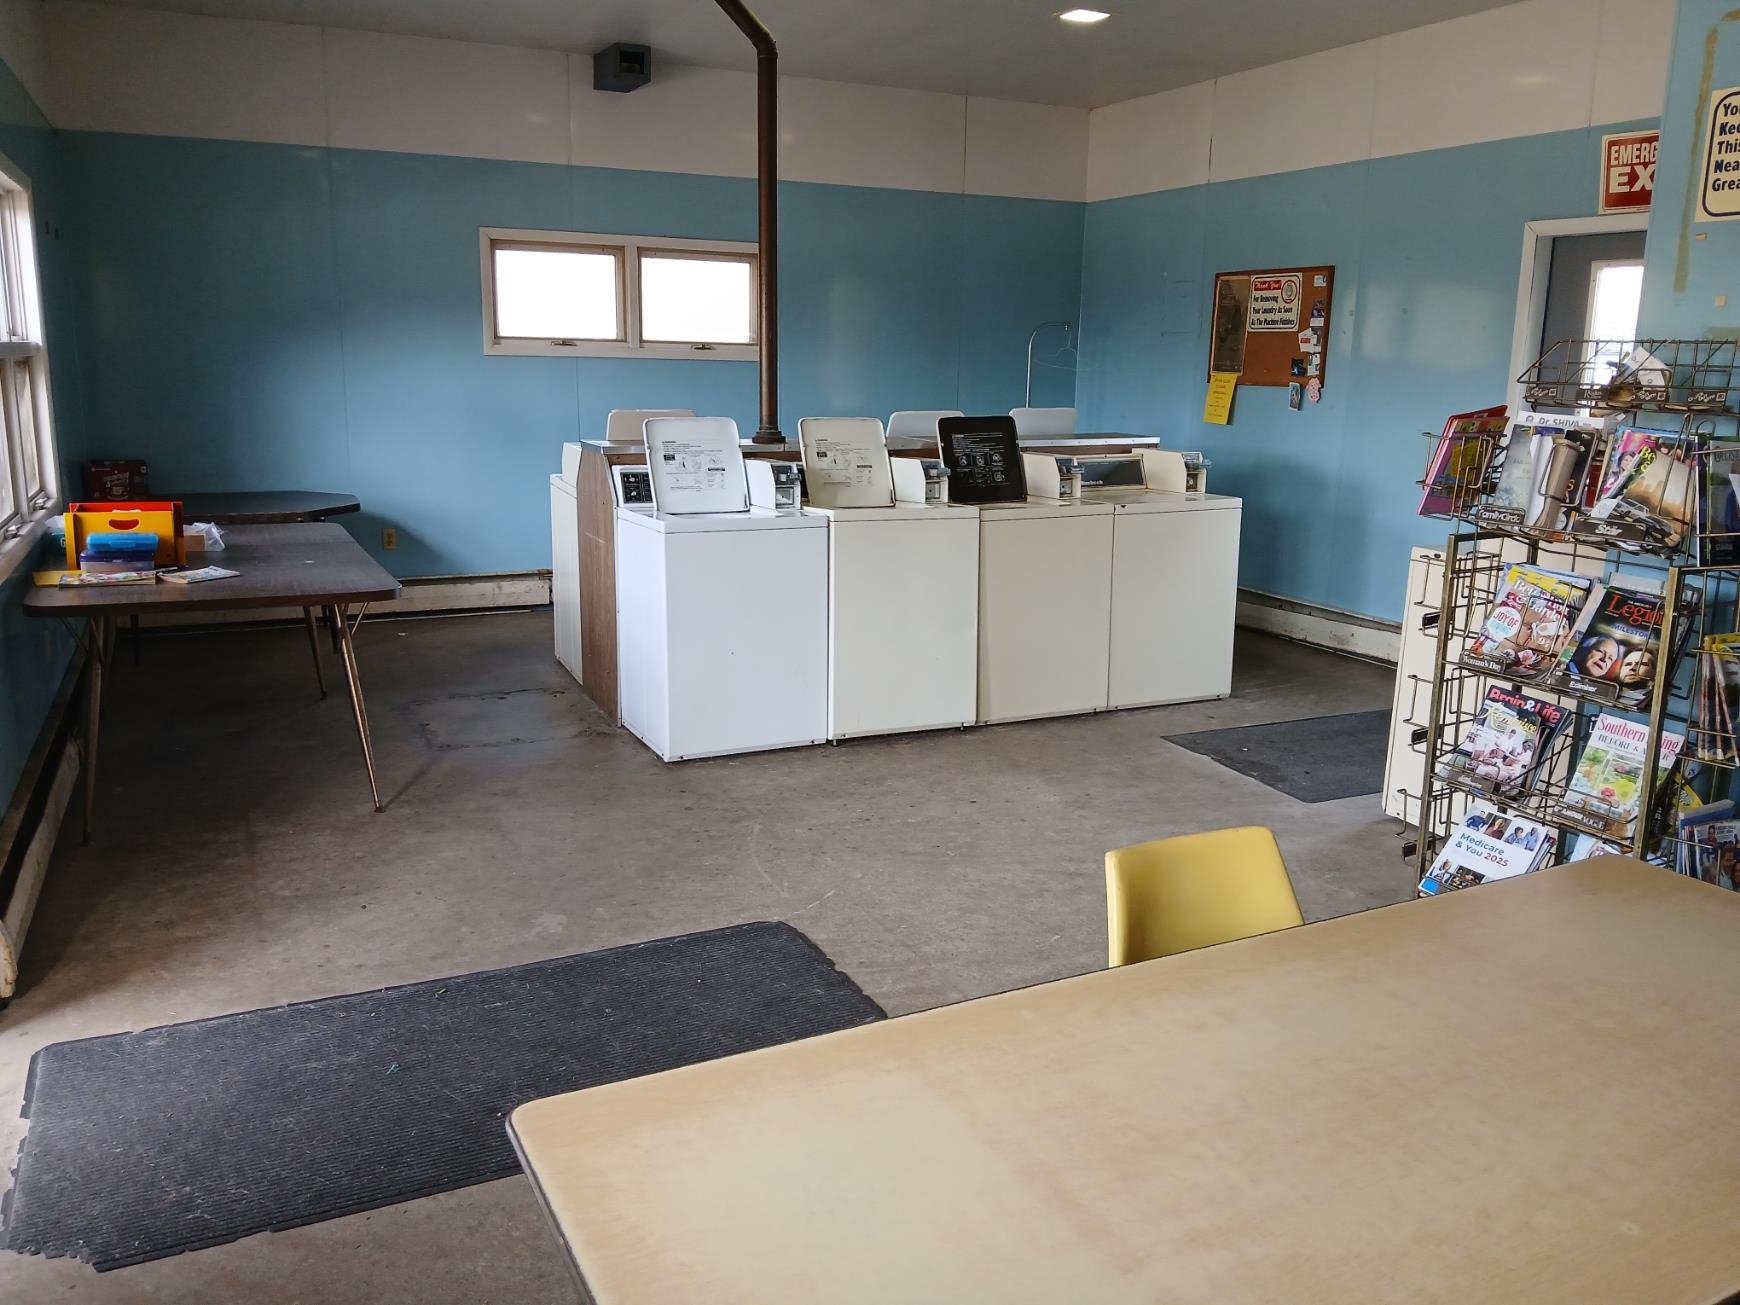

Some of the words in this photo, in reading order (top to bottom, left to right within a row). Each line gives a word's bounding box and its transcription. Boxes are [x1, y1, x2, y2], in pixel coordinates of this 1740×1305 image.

[1723, 102, 1740, 117] Yo
[1610, 141, 1659, 166] EMERG
[1608, 163, 1657, 194] EX
[1260, 294, 1279, 303] Removing
[1252, 306, 1261, 314] Your
[1261, 305, 1277, 315] Laundry
[1277, 305, 1283, 314] As
[1283, 305, 1293, 314] Soon
[1256, 317, 1264, 326] The
[1264, 317, 1279, 326] Machine
[1279, 317, 1295, 326] Finishes
[1553, 418, 1580, 428] SHIVA
[1493, 611, 1509, 623] JOY
[1507, 617, 1520, 628] OF
[1597, 717, 1647, 743] Southern
[1598, 733, 1631, 750] BEFORE
[1460, 832, 1505, 856] Medicare
[1465, 845, 1483, 857] You
[1483, 852, 1510, 867] 2025
